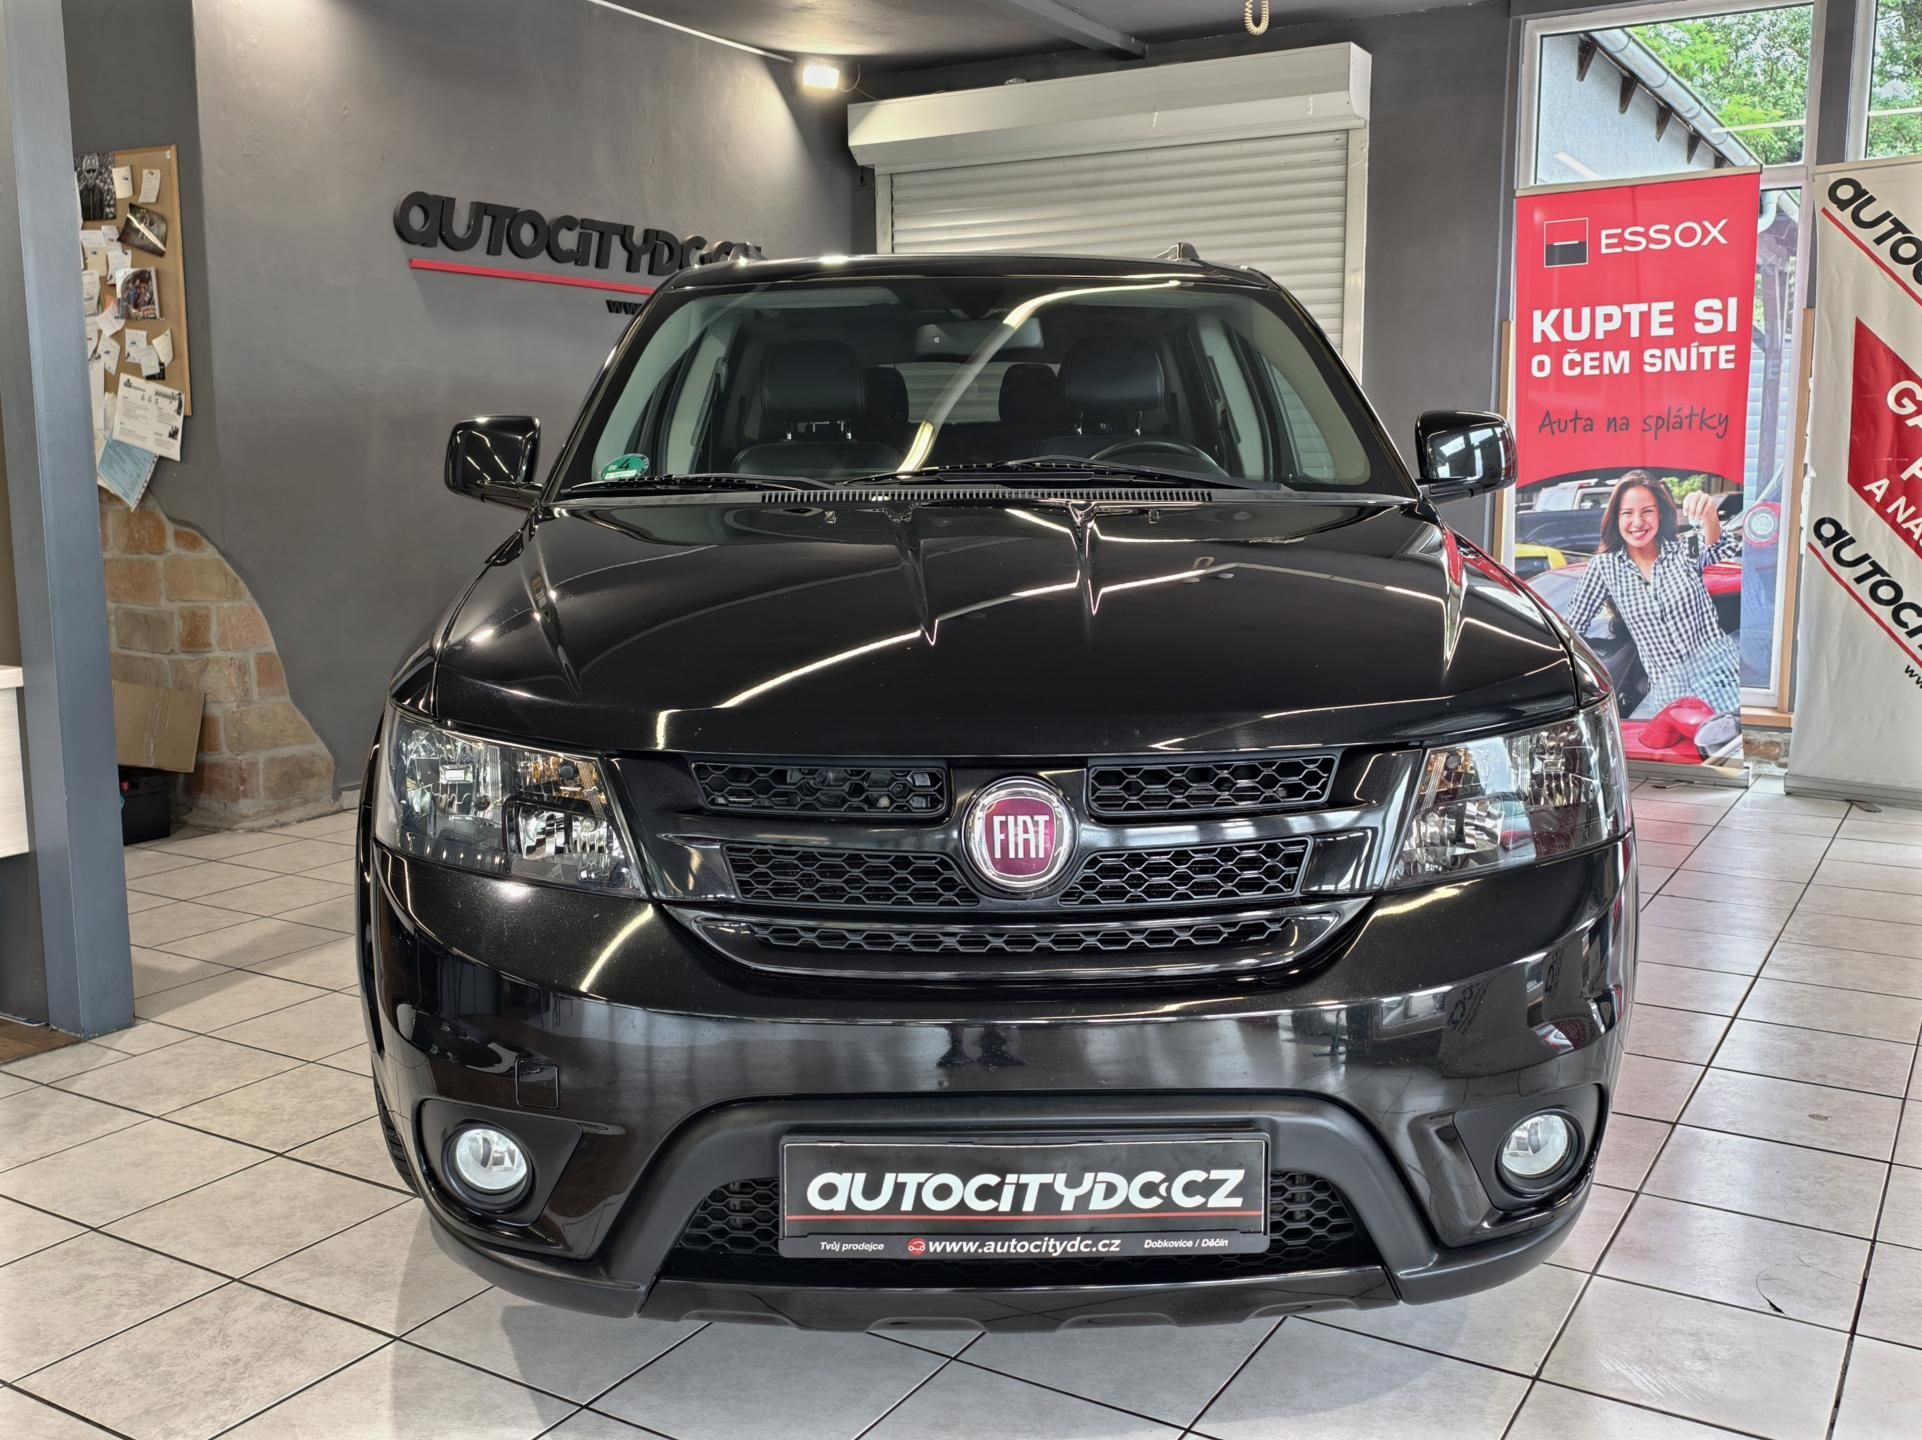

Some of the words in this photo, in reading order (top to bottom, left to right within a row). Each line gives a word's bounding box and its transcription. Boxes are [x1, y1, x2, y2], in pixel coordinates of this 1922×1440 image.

[1600, 219, 1728, 254] ESSOX
[1532, 302, 1675, 344] KUPTE
[1693, 297, 1738, 335] SI
[1531, 354, 1551, 378] O
[1562, 348, 1631, 377] ČEM
[1642, 341, 1736, 374] SNÍTE
[1538, 409, 1594, 436] Auta
[1606, 414, 1630, 433] na
[1641, 405, 1729, 440] splátky
[1863, 478, 1890, 503] A
[992, 815, 1050, 859] FIAT
[819, 1241, 840, 1252] Tvůj
[842, 1241, 885, 1252] prodejce
[928, 1236, 1122, 1257] www.autocitydc.cz
[1144, 1239, 1193, 1249] Dobkovice
[1201, 1238, 1229, 1248] Děčín
